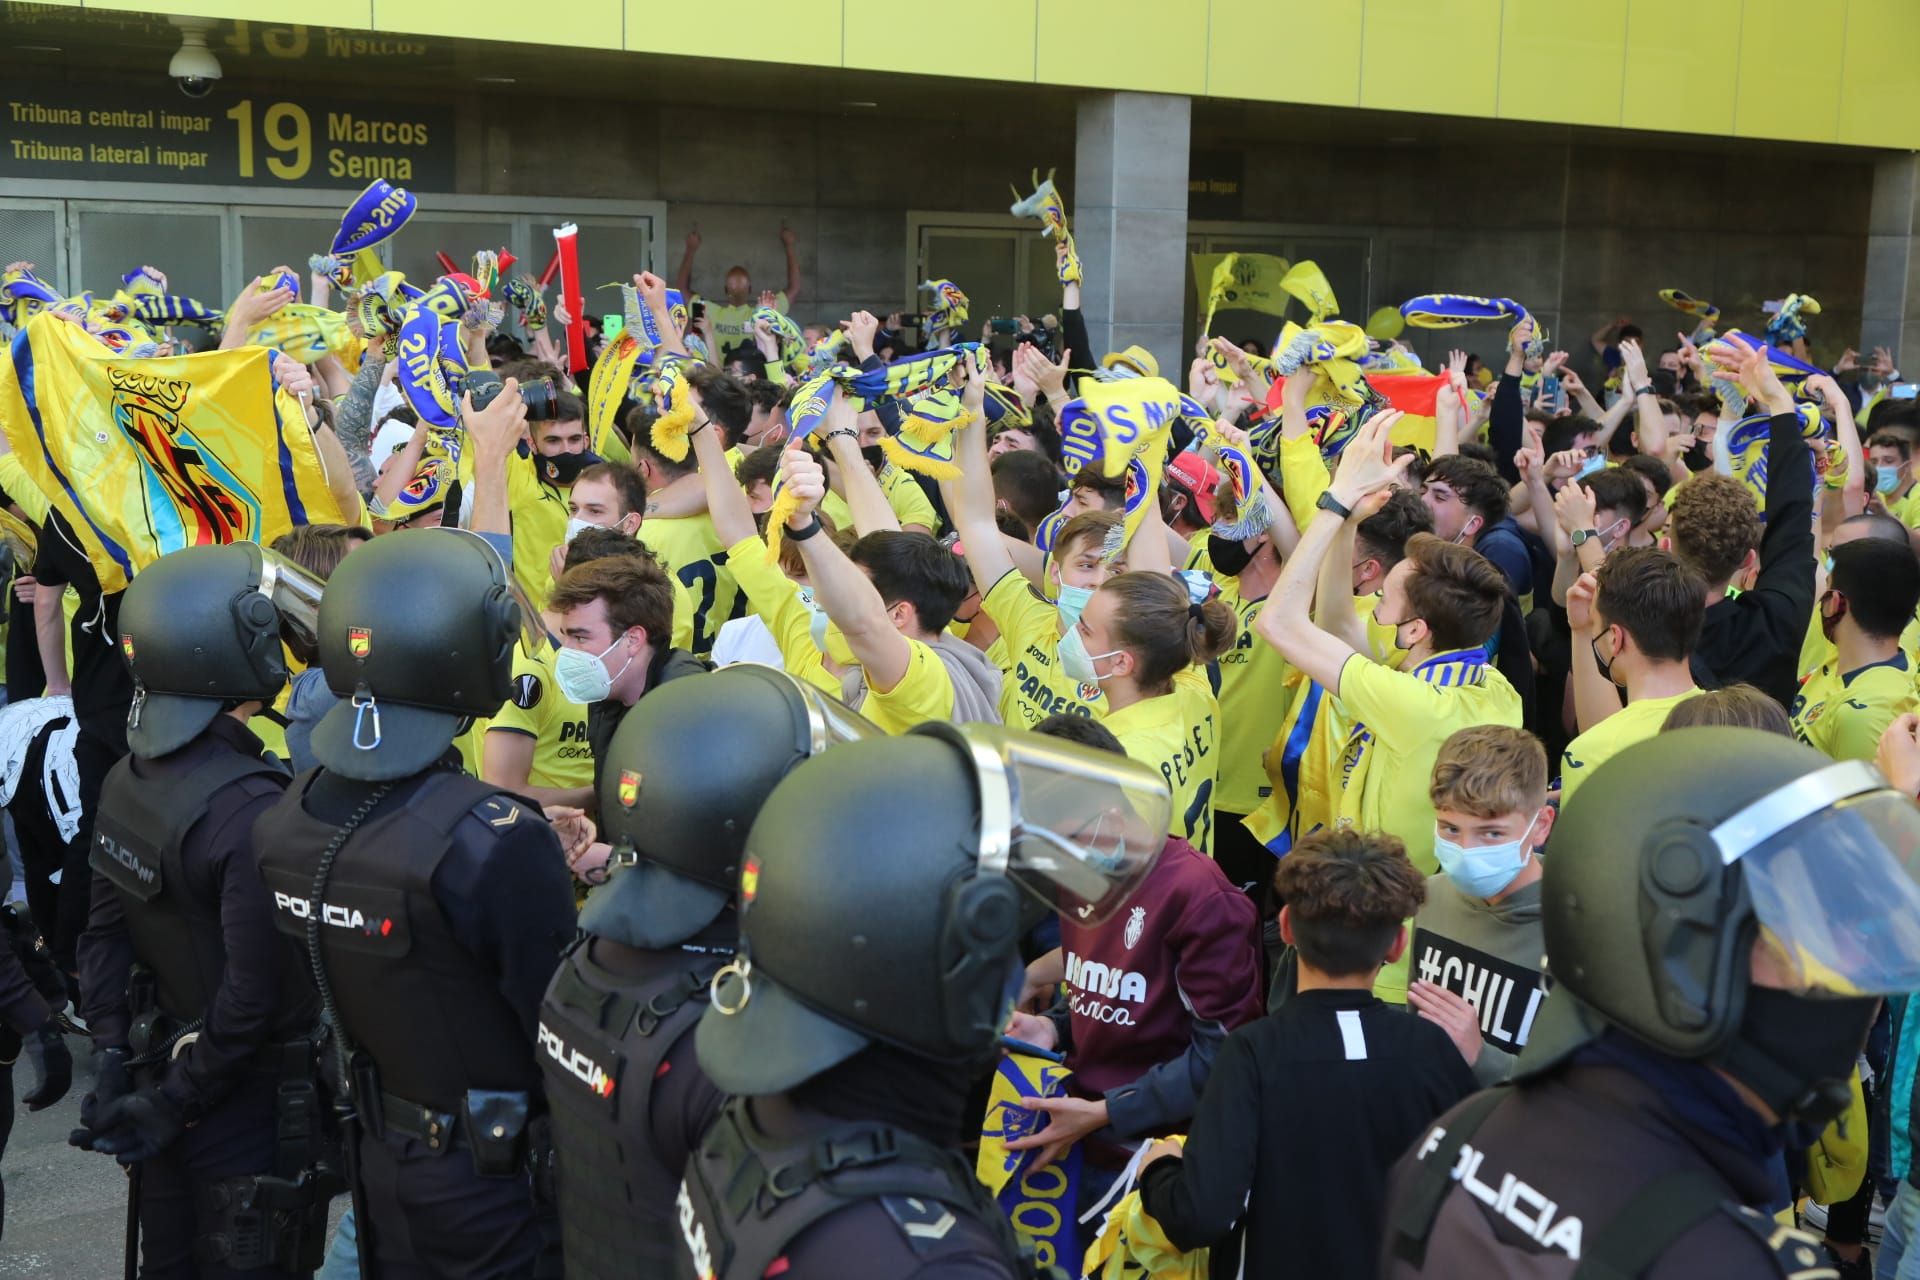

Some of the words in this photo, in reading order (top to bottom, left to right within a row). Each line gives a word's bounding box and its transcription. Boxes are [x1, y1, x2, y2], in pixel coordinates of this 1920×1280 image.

[9, 102, 82, 126] Tribuna
[88, 109, 154, 129] central
[160, 110, 212, 135] impar
[328, 112, 428, 145] Marcos
[10, 139, 84, 162] Tribuna
[90, 144, 150, 165] lateral
[157, 146, 209, 171] impar
[226, 99, 312, 180] 19
[328, 148, 412, 180] Senna
[96, 831, 140, 873] POLICIA
[274, 890, 365, 929] POLICIA
[537, 1021, 604, 1094] POLICIA
